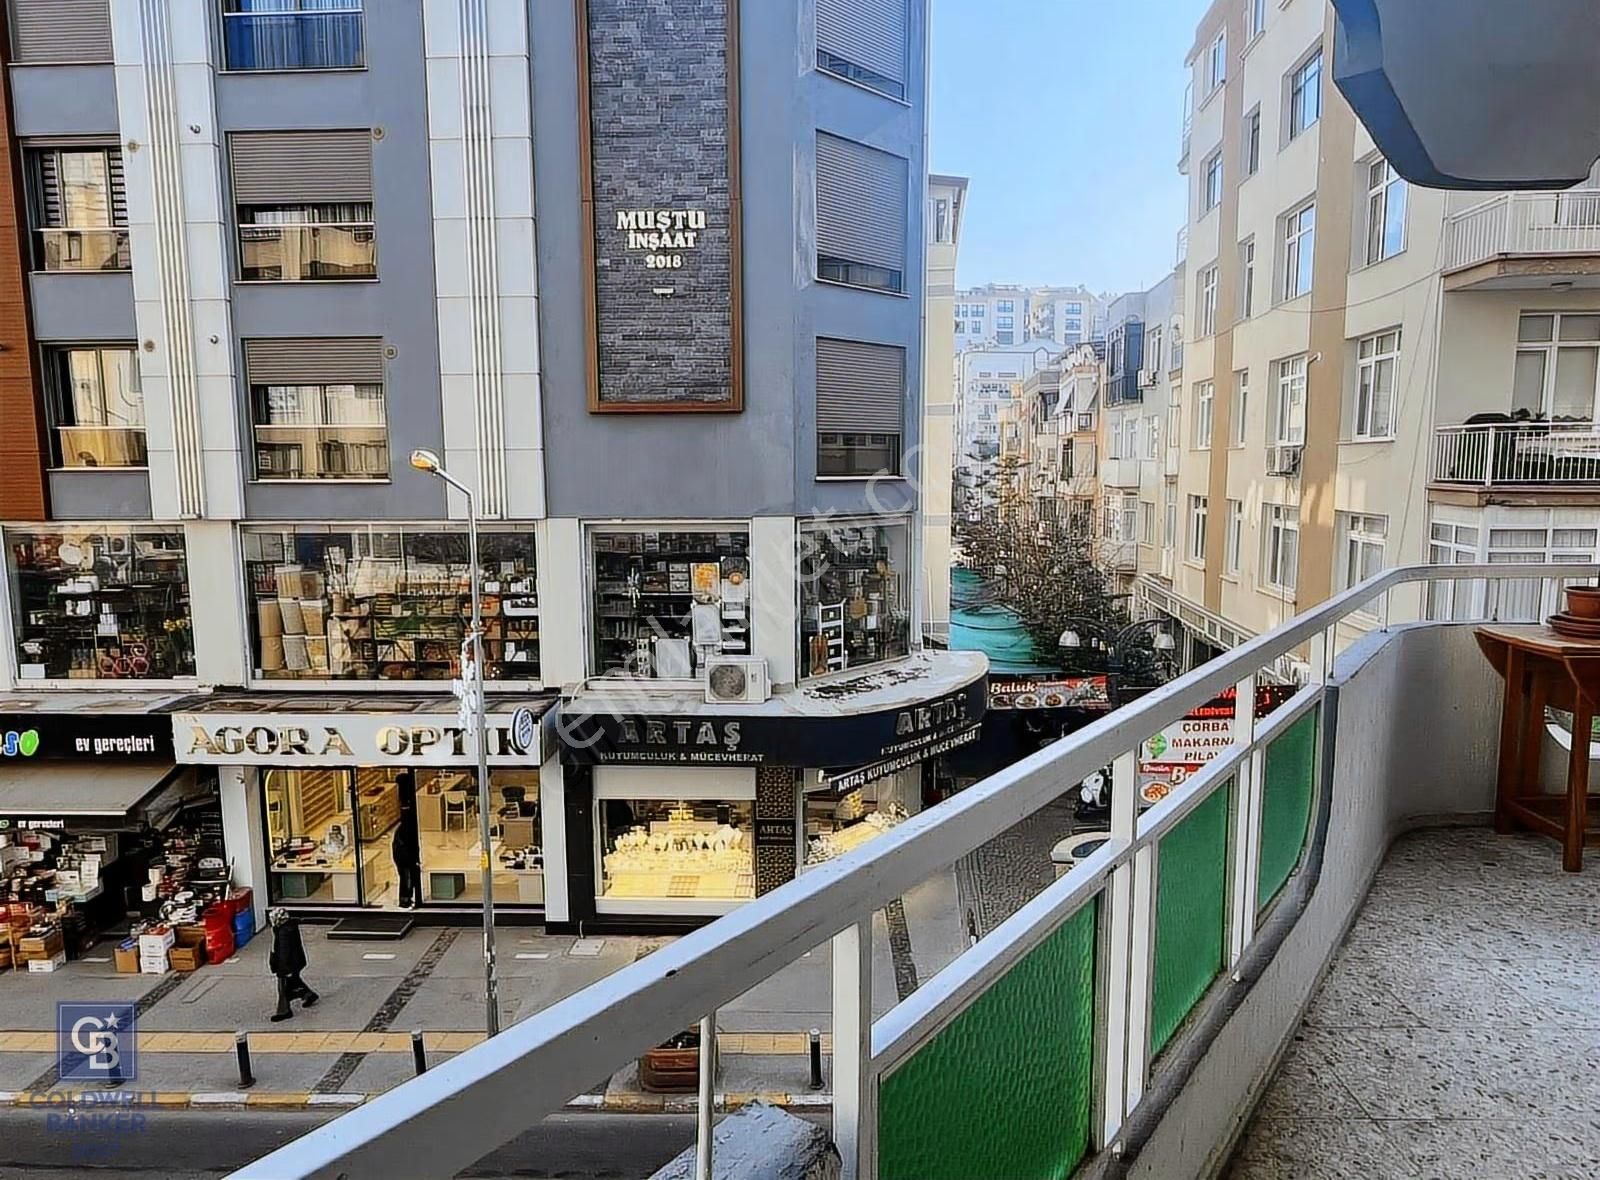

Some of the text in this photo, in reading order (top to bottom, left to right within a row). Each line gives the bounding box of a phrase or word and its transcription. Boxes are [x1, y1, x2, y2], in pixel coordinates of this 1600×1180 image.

[616, 210, 706, 232] MUŞTU
[627, 230, 697, 251] İNŞAAT
[646, 255, 682, 268] 2018
[617, 720, 742, 751] ARTAŞ
[1182, 723, 1229, 734] ÇORBA
[76, 735, 155, 754] ev gereçleri
[187, 726, 354, 756] AGORA
[680, 752, 688, 760] &
[838, 773, 865, 793] ARTAŞ
[867, 752, 922, 781] KUYUMCULUK
